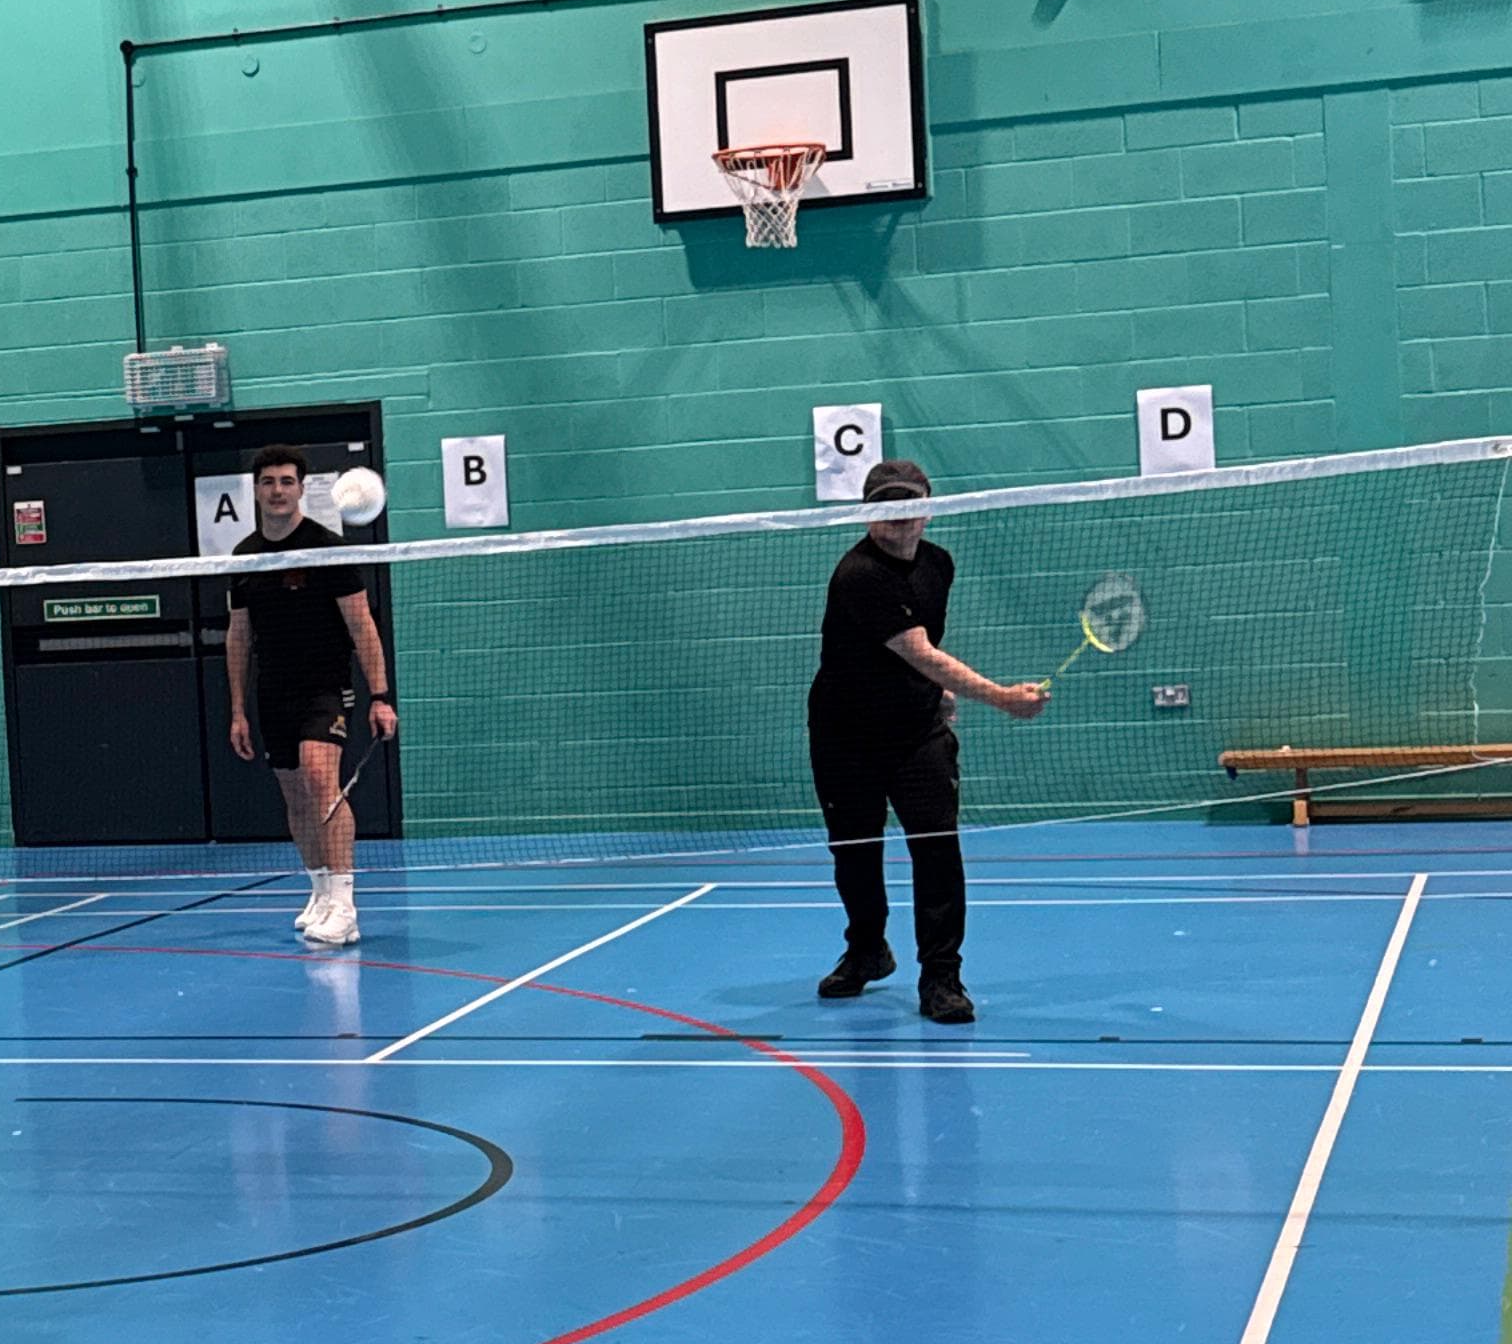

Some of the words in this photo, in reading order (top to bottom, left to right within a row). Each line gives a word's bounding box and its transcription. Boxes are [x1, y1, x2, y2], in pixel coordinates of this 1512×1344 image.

[834, 423, 864, 456] C
[1161, 407, 1191, 441] D
[463, 455, 487, 486] B
[214, 492, 239, 523] A
[53, 604, 82, 615] Push
[85, 603, 103, 614] bar
[106, 603, 117, 613] to
[120, 602, 148, 614] open
